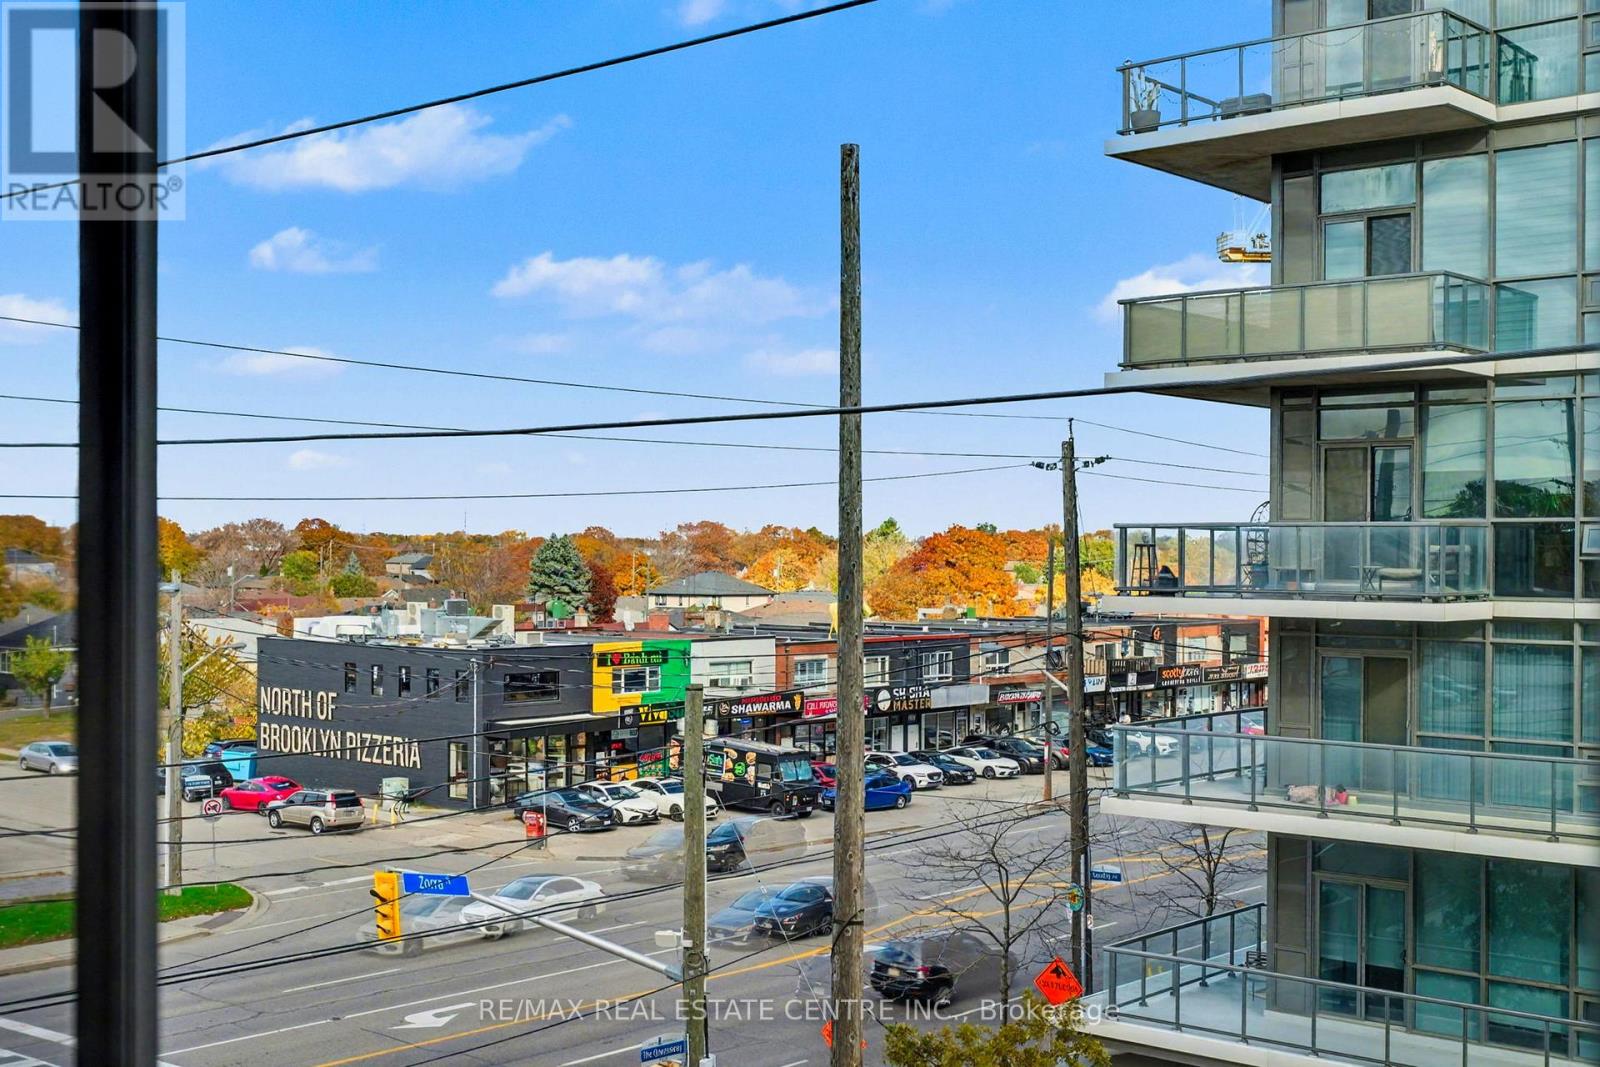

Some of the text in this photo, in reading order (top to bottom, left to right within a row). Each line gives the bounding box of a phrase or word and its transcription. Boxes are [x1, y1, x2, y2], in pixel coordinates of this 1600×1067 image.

[892, 686, 931, 700] SHSHA
[260, 686, 337, 721] NORTH OF
[730, 700, 792, 714] SHAWARMA
[893, 698, 934, 712] MASTER
[260, 722, 422, 769] BROOKLYN PIZZERIA
